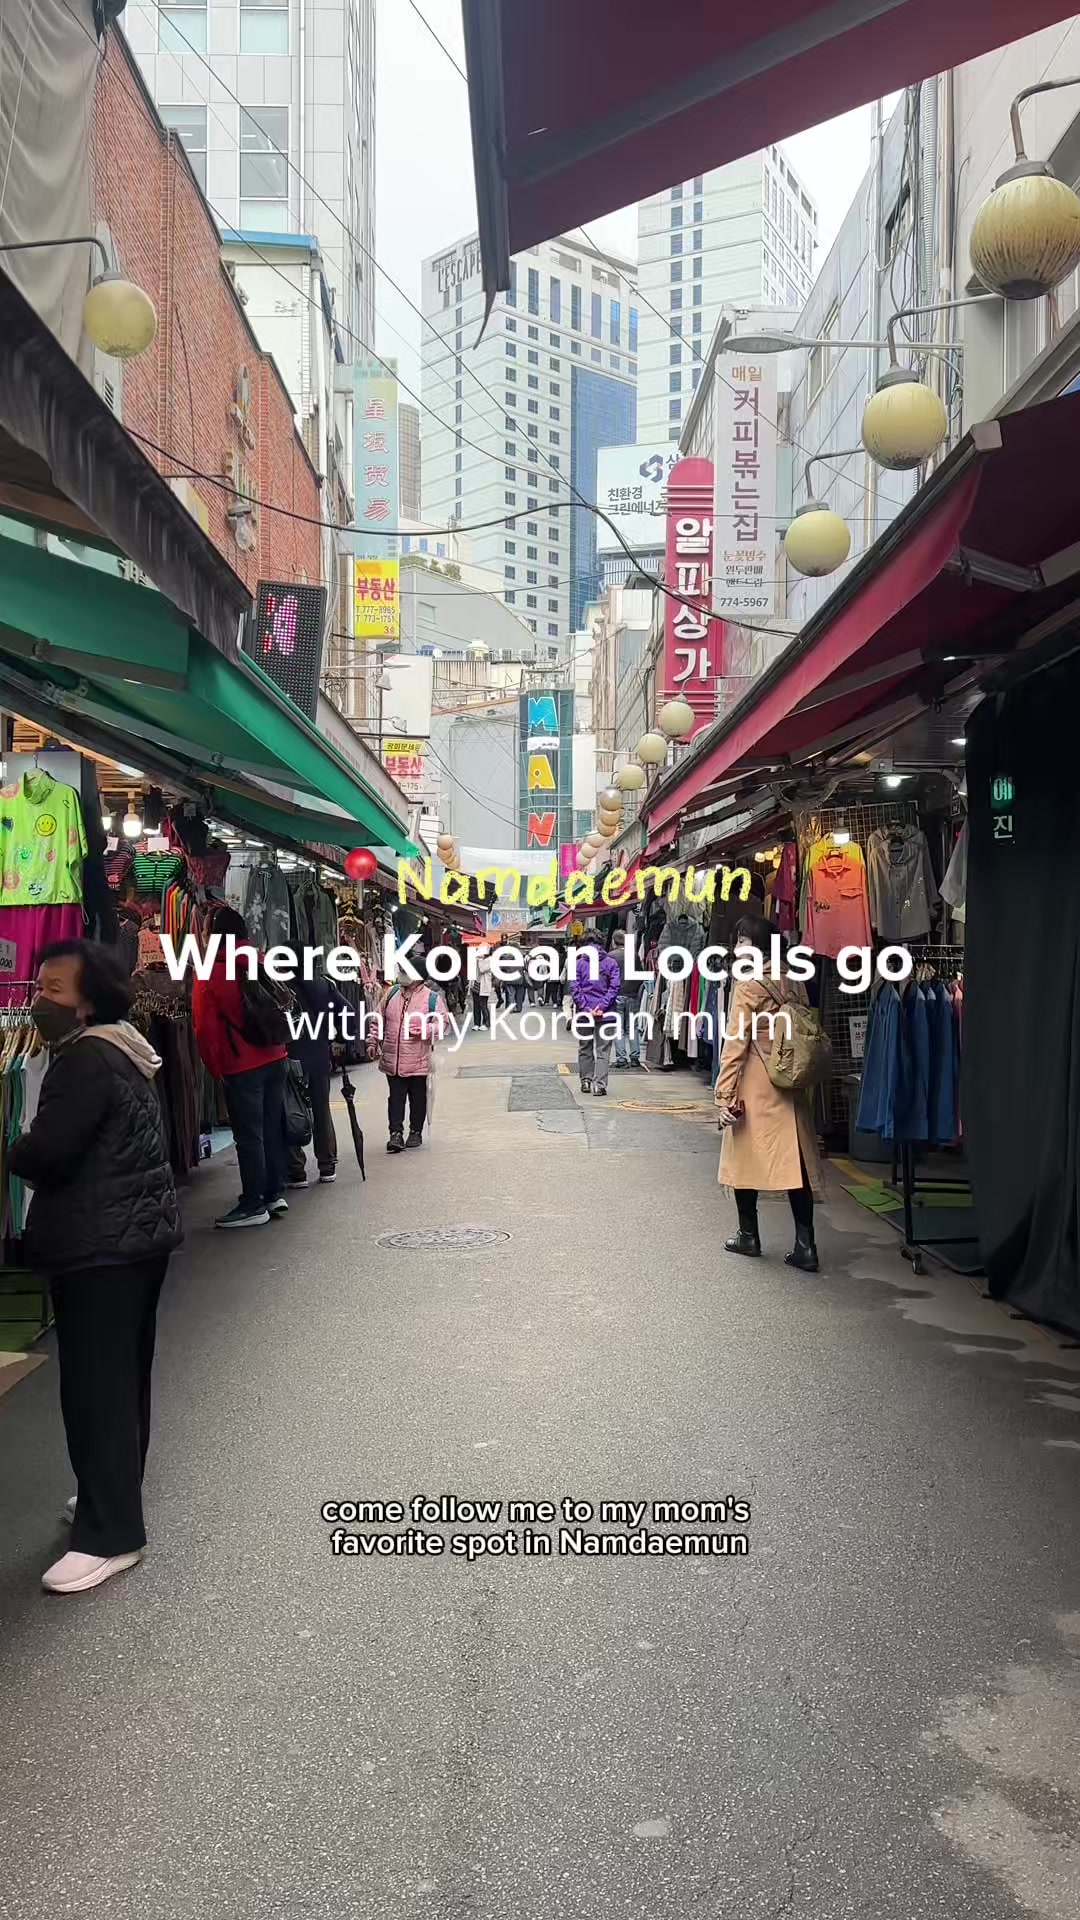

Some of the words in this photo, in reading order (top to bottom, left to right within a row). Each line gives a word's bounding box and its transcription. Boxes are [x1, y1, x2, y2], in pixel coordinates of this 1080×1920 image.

[731, 366, 762, 382] 매일
[731, 387, 761, 541] 커피볶는집
[607, 486, 643, 501] 친환경
[356, 577, 395, 601] 부동산
[720, 597, 769, 607] 774-5967
